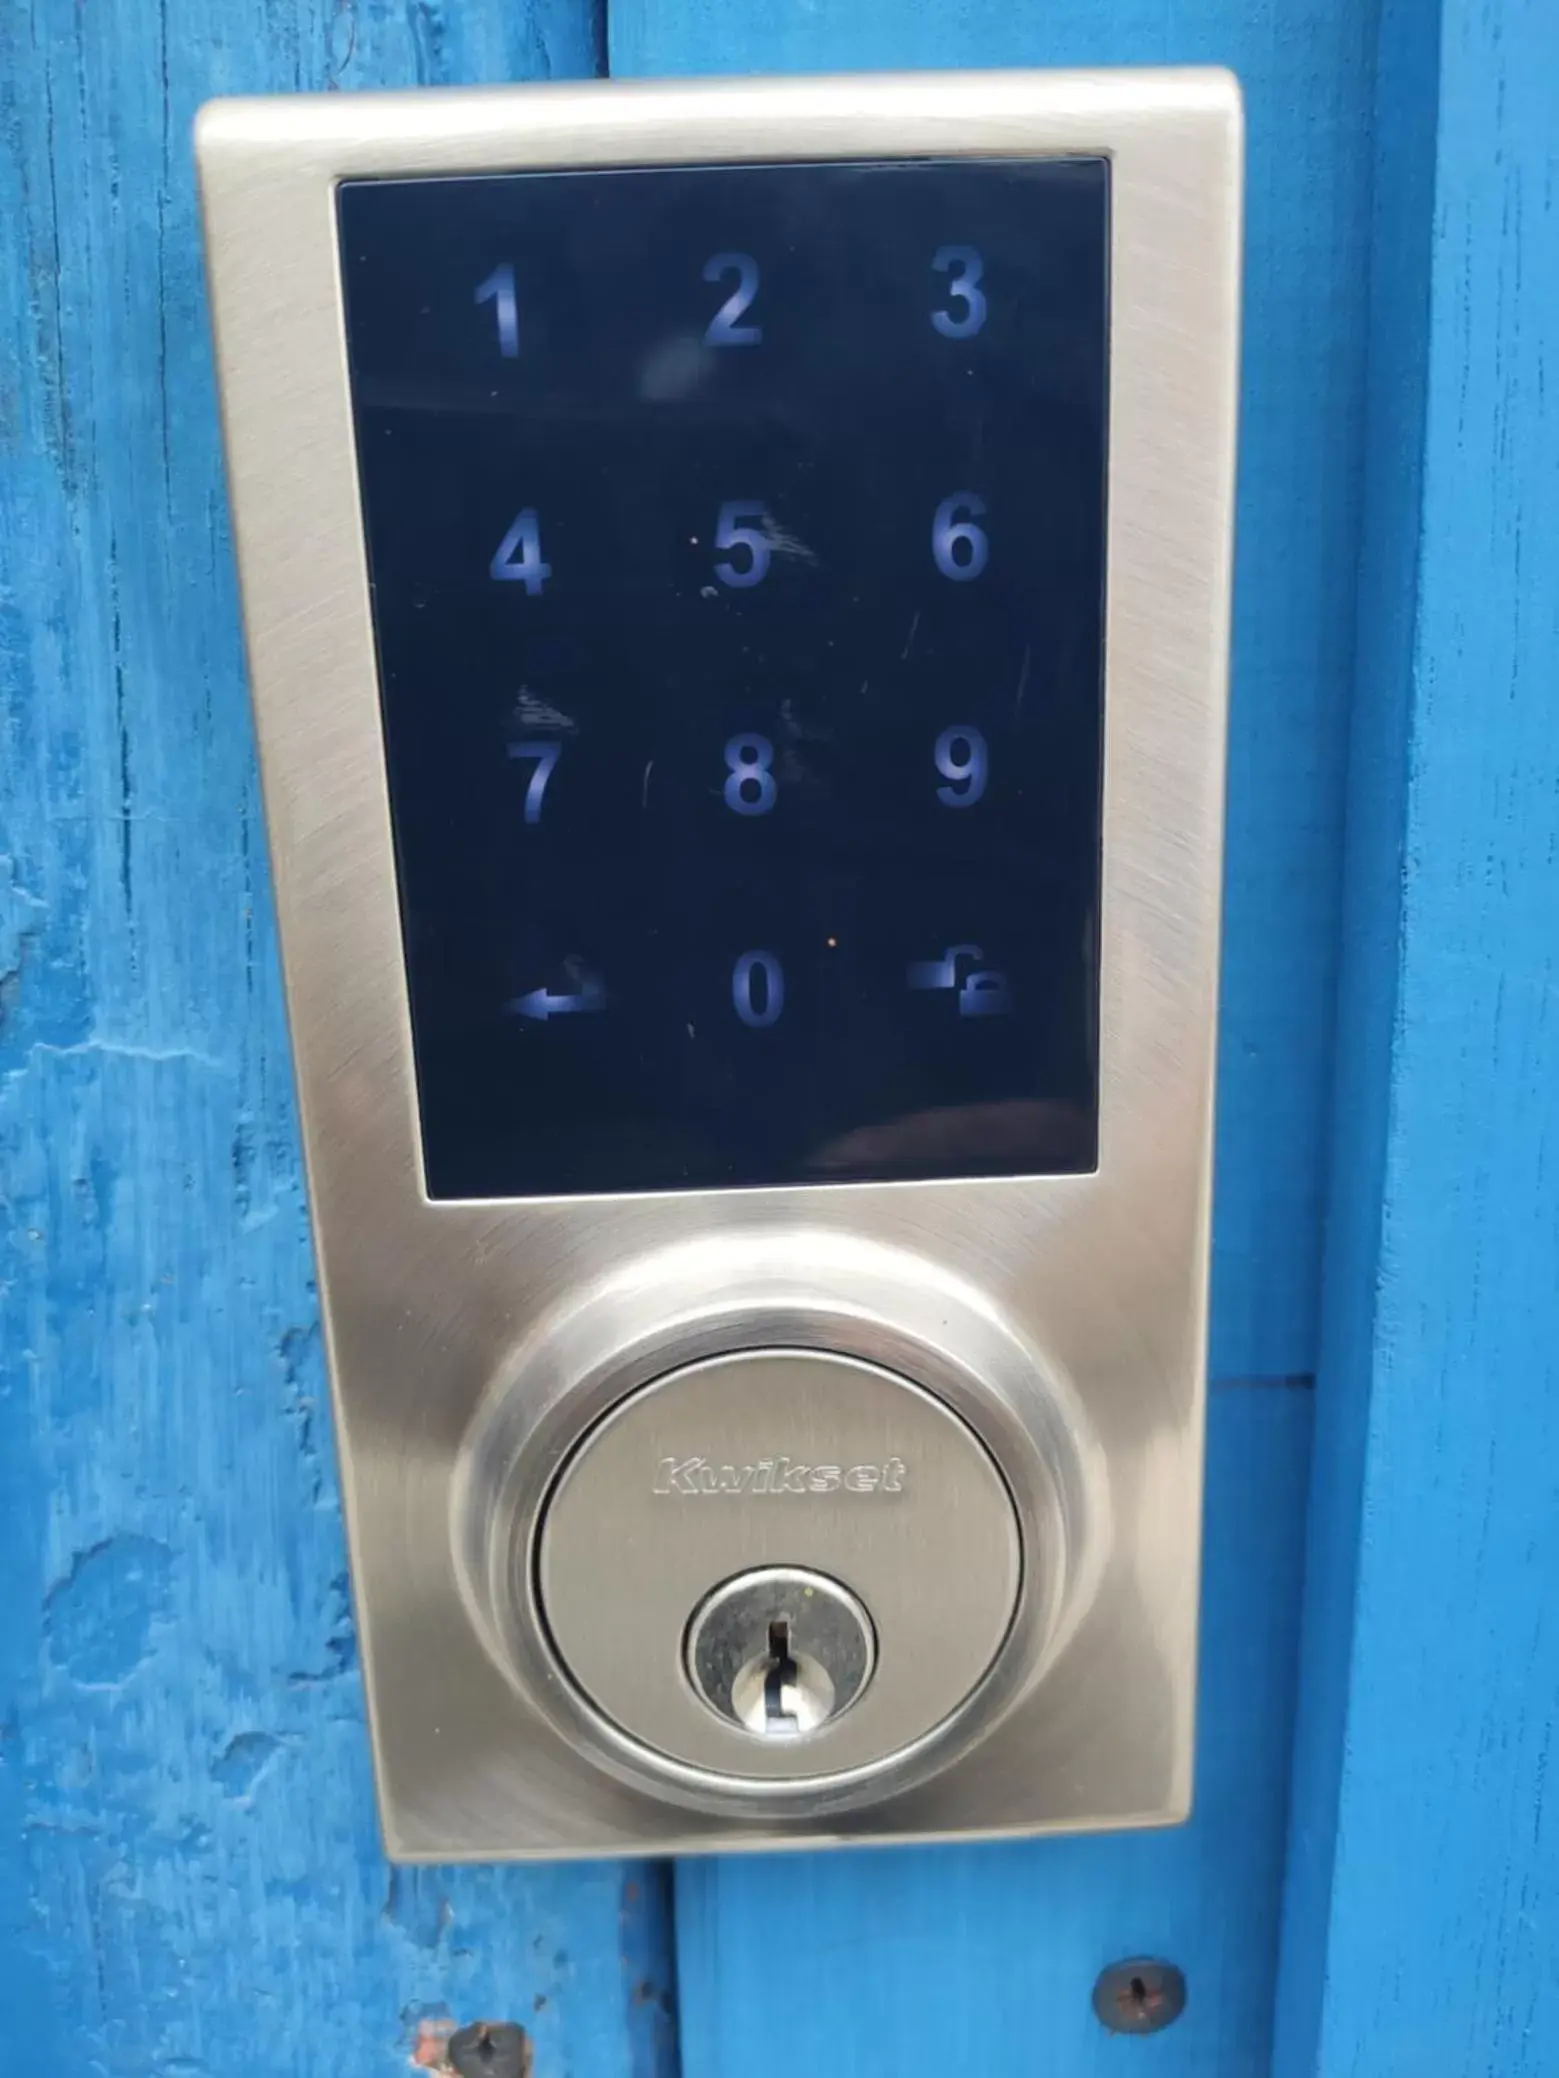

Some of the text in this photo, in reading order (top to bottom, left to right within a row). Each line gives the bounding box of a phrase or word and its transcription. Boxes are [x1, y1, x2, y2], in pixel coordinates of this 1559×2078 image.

[474, 245, 987, 358] 1 2 3
[489, 490, 989, 596] 4 5 6
[506, 725, 989, 824] 7 8 9
[731, 949, 784, 1028] 0
[652, 1457, 907, 1495] Kwikset
